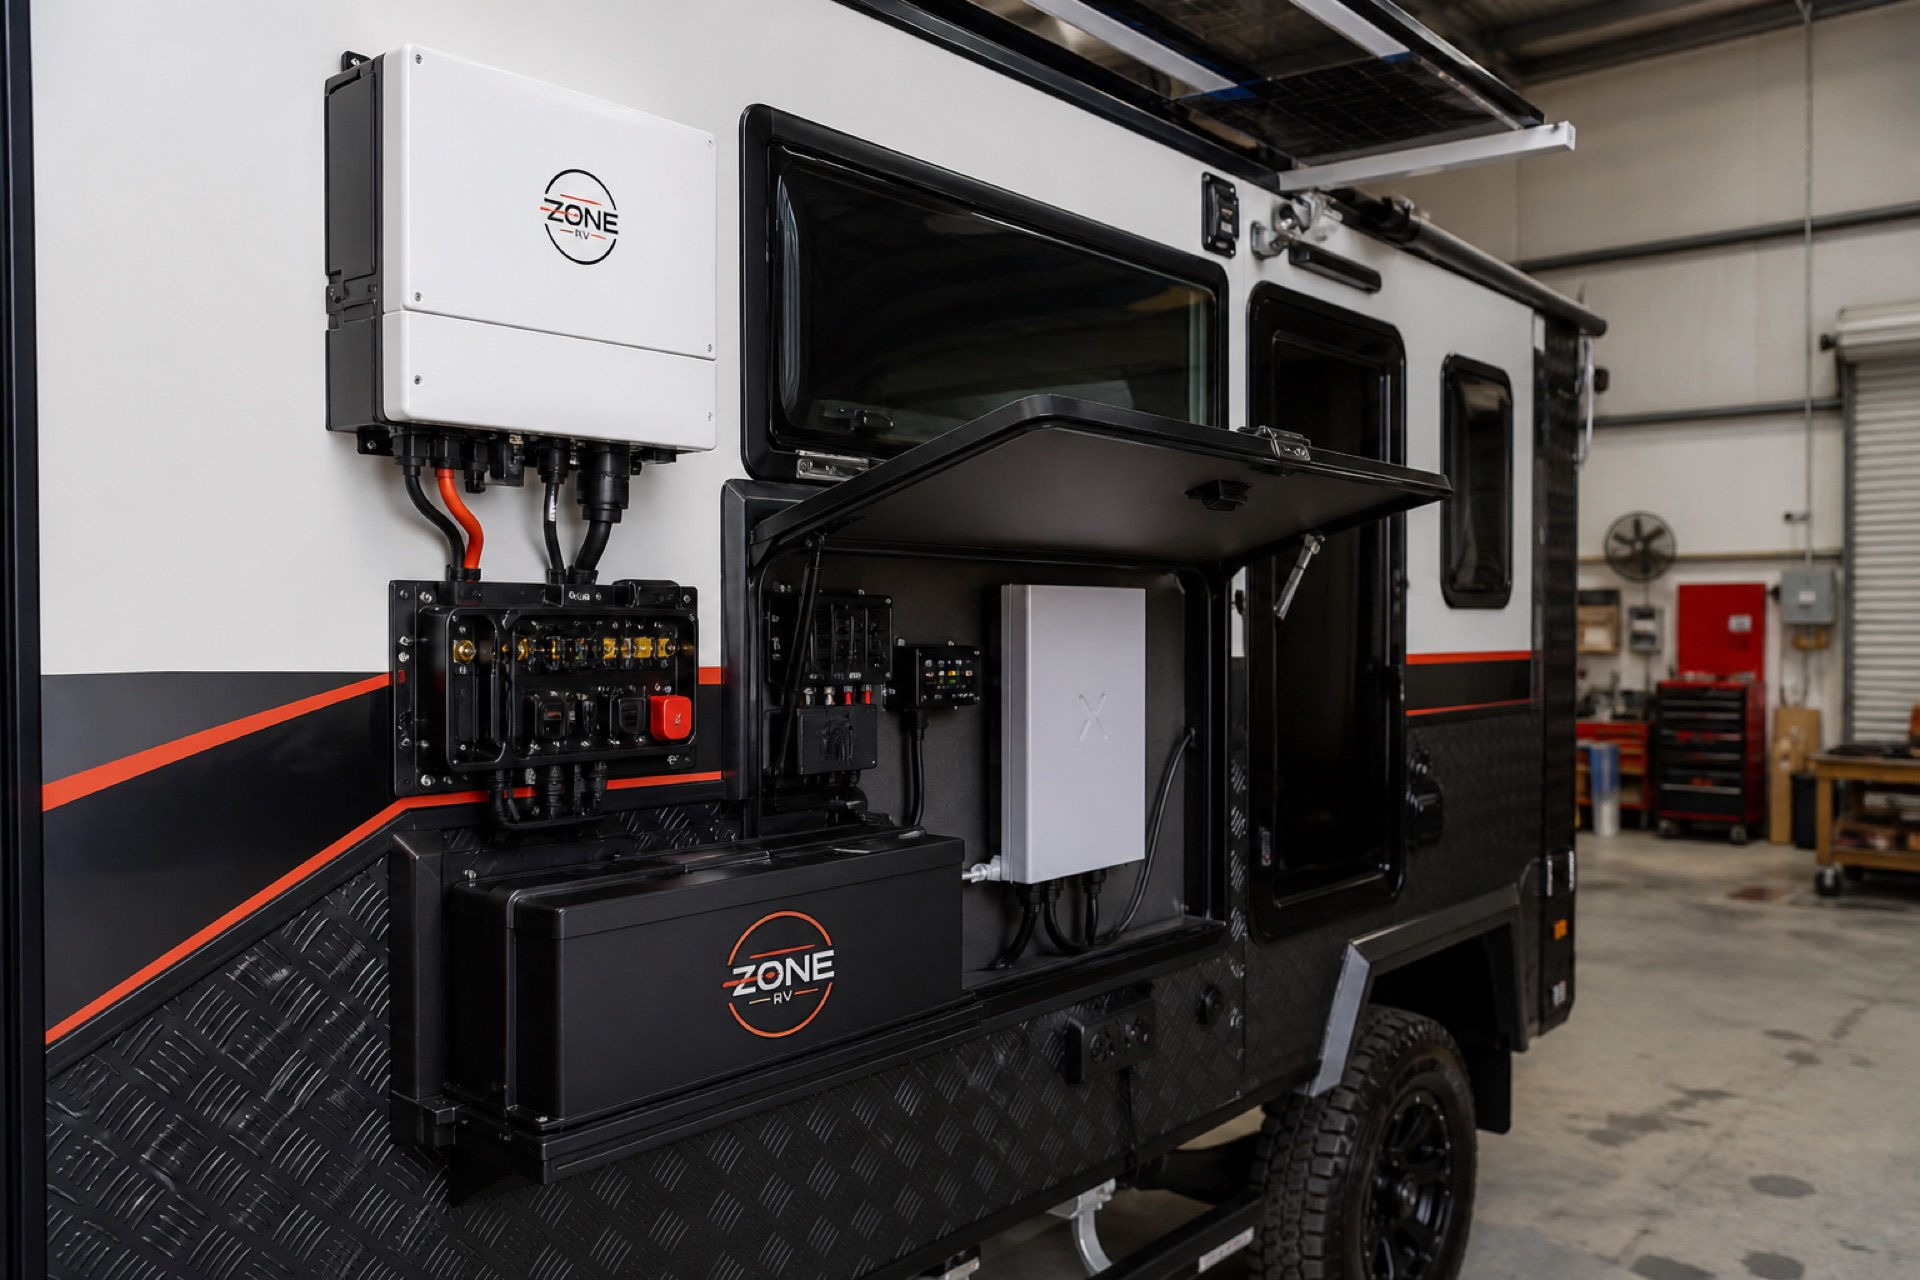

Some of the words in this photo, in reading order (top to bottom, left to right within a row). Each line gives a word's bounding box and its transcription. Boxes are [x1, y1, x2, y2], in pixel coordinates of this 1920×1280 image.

[543, 197, 619, 235] ZONE
[575, 229, 590, 240] RV
[732, 949, 835, 997] ZONE
[773, 990, 793, 1005] RV
